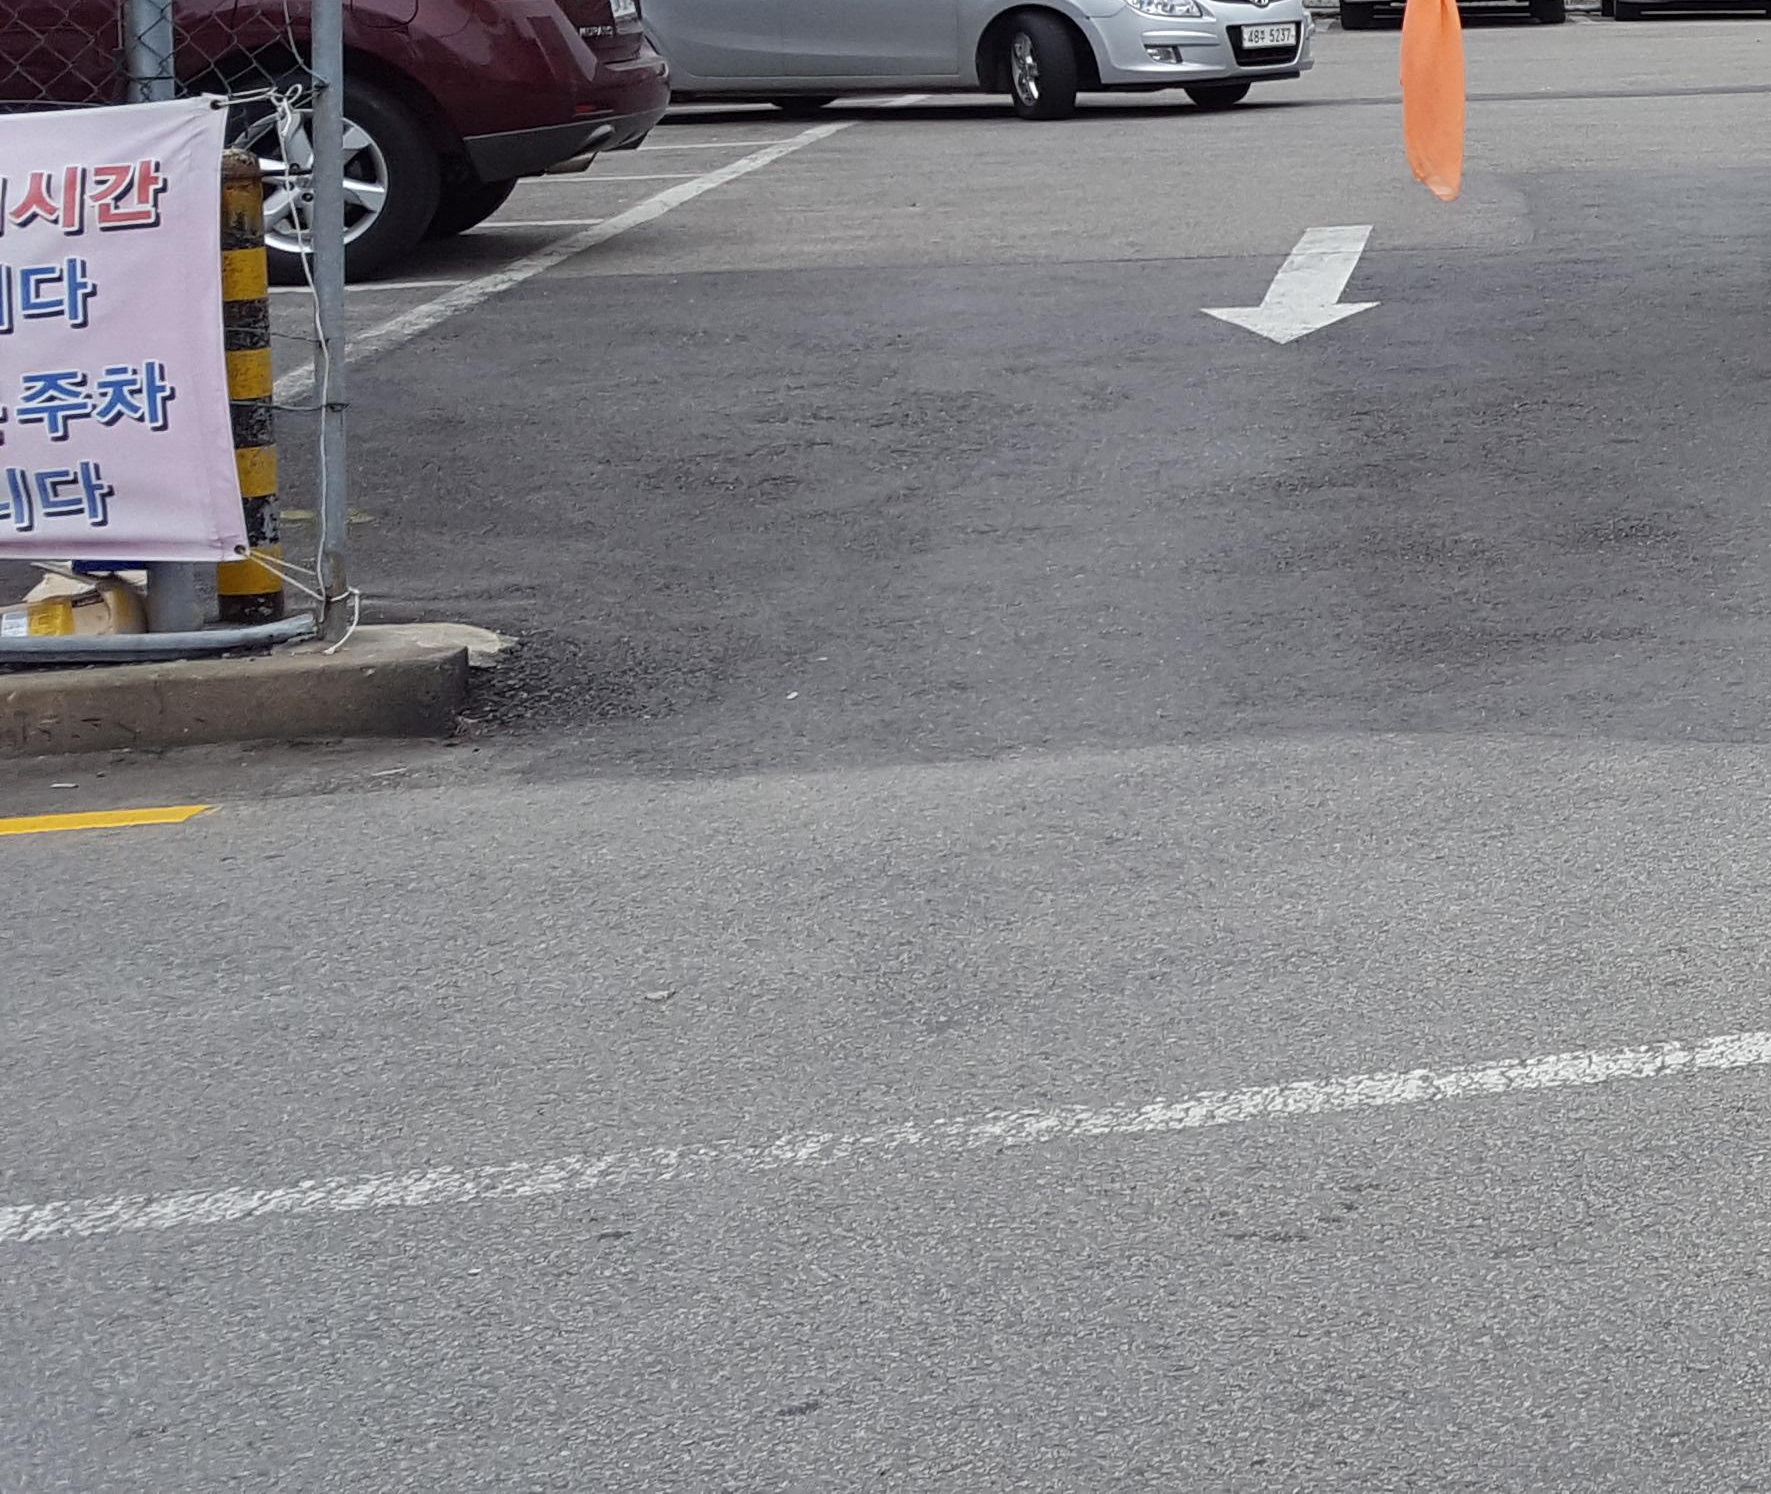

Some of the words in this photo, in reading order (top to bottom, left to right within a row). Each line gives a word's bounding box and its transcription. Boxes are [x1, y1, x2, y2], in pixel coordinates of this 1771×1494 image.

[1269, 27, 1291, 42] 5237
[0, 158, 168, 229] 시간
[15, 359, 175, 442] 주차
